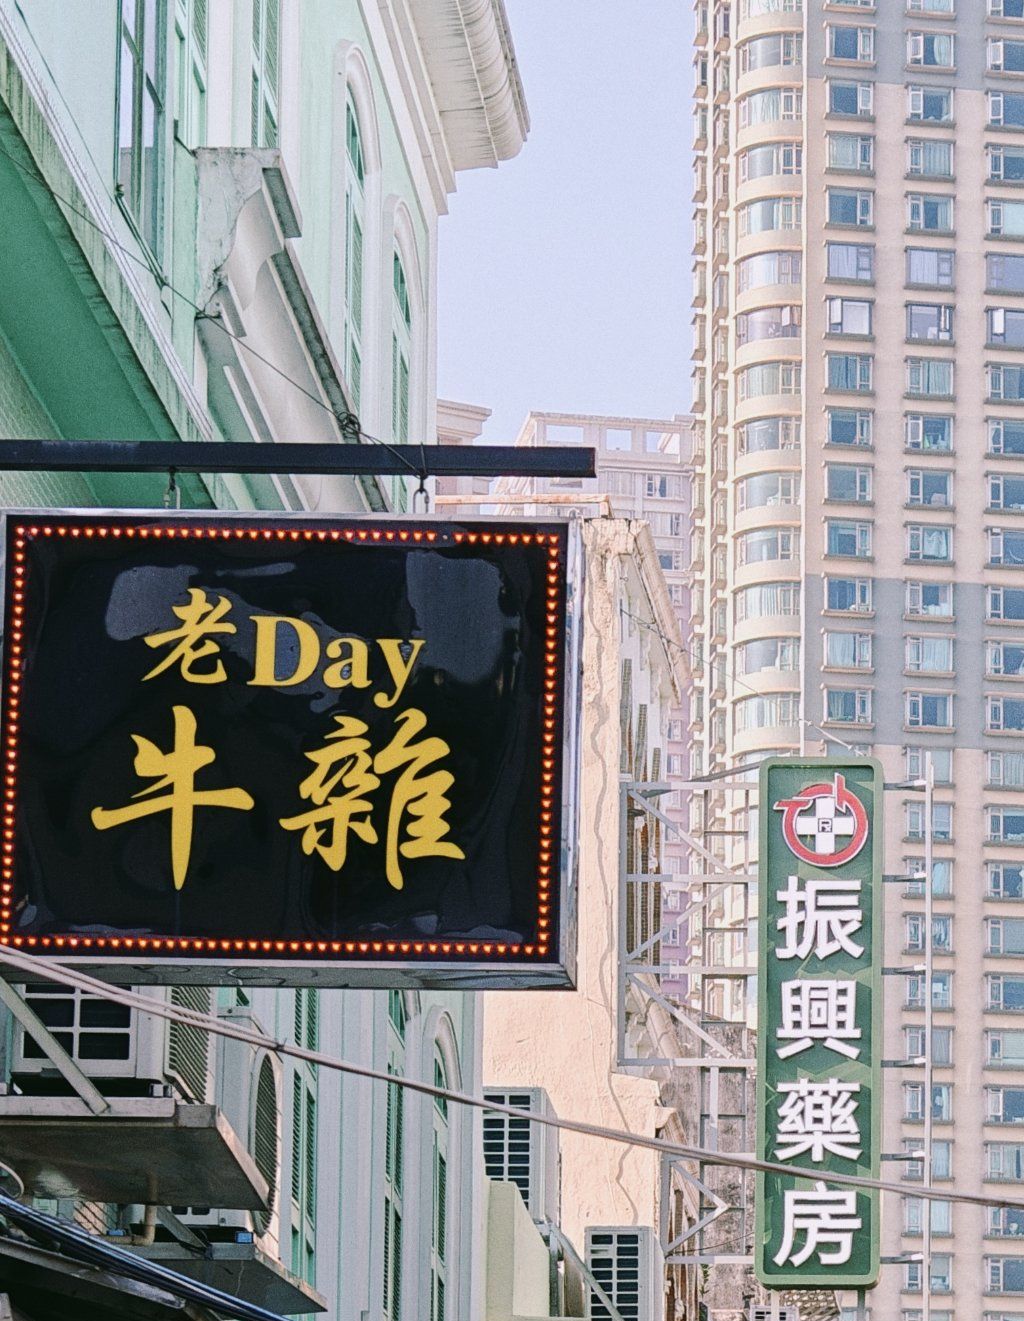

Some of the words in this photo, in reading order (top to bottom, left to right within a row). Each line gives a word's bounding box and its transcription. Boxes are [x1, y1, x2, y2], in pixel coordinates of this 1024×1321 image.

[90, 704, 467, 891] 牛雜
[773, 875, 866, 1269] 振興藥房
